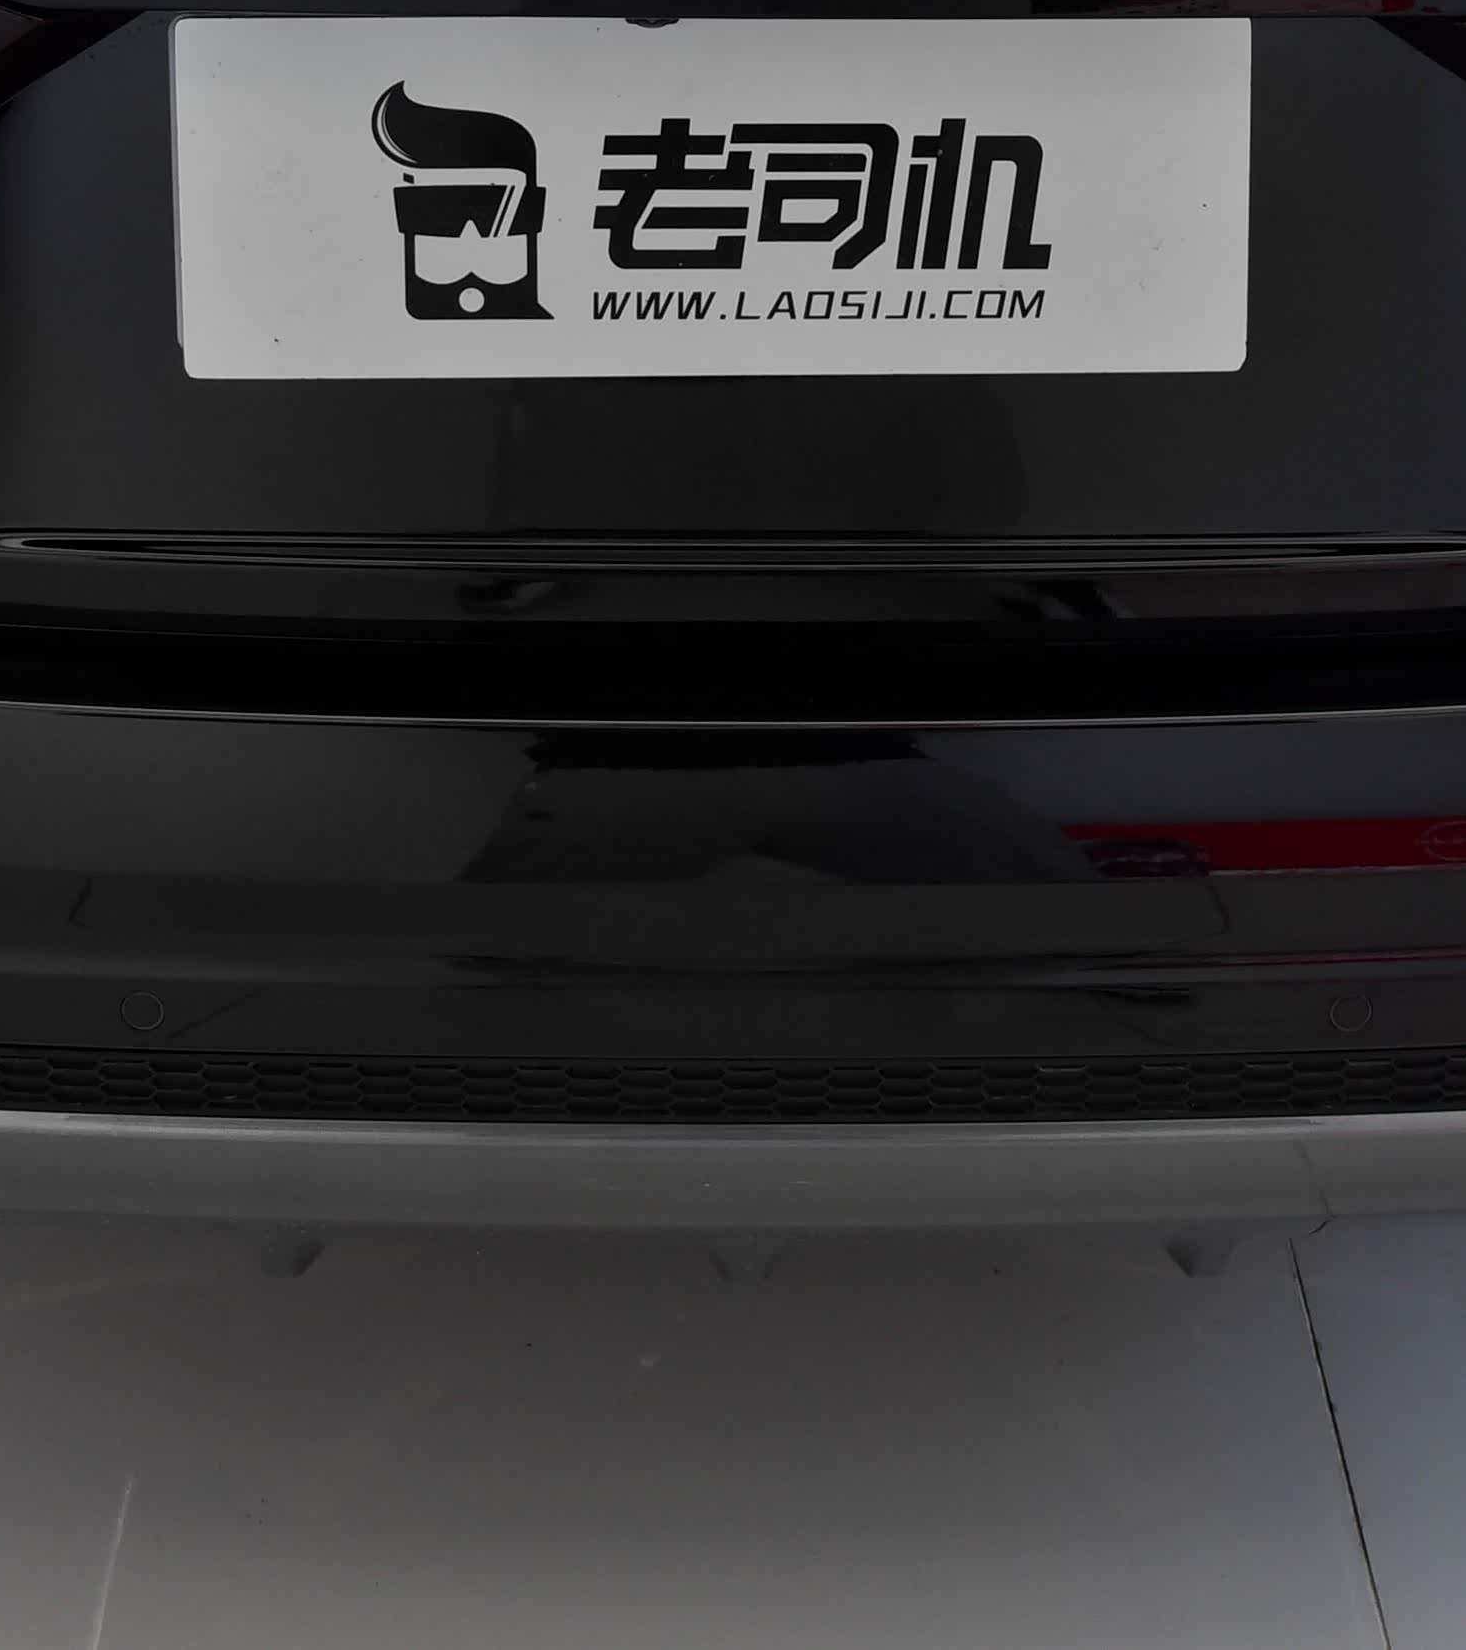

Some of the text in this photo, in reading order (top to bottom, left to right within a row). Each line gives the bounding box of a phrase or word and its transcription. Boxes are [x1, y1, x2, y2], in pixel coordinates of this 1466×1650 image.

[593, 118, 1052, 269] 老司机
[593, 290, 1045, 320] WWW.LAOSIJI.COM
